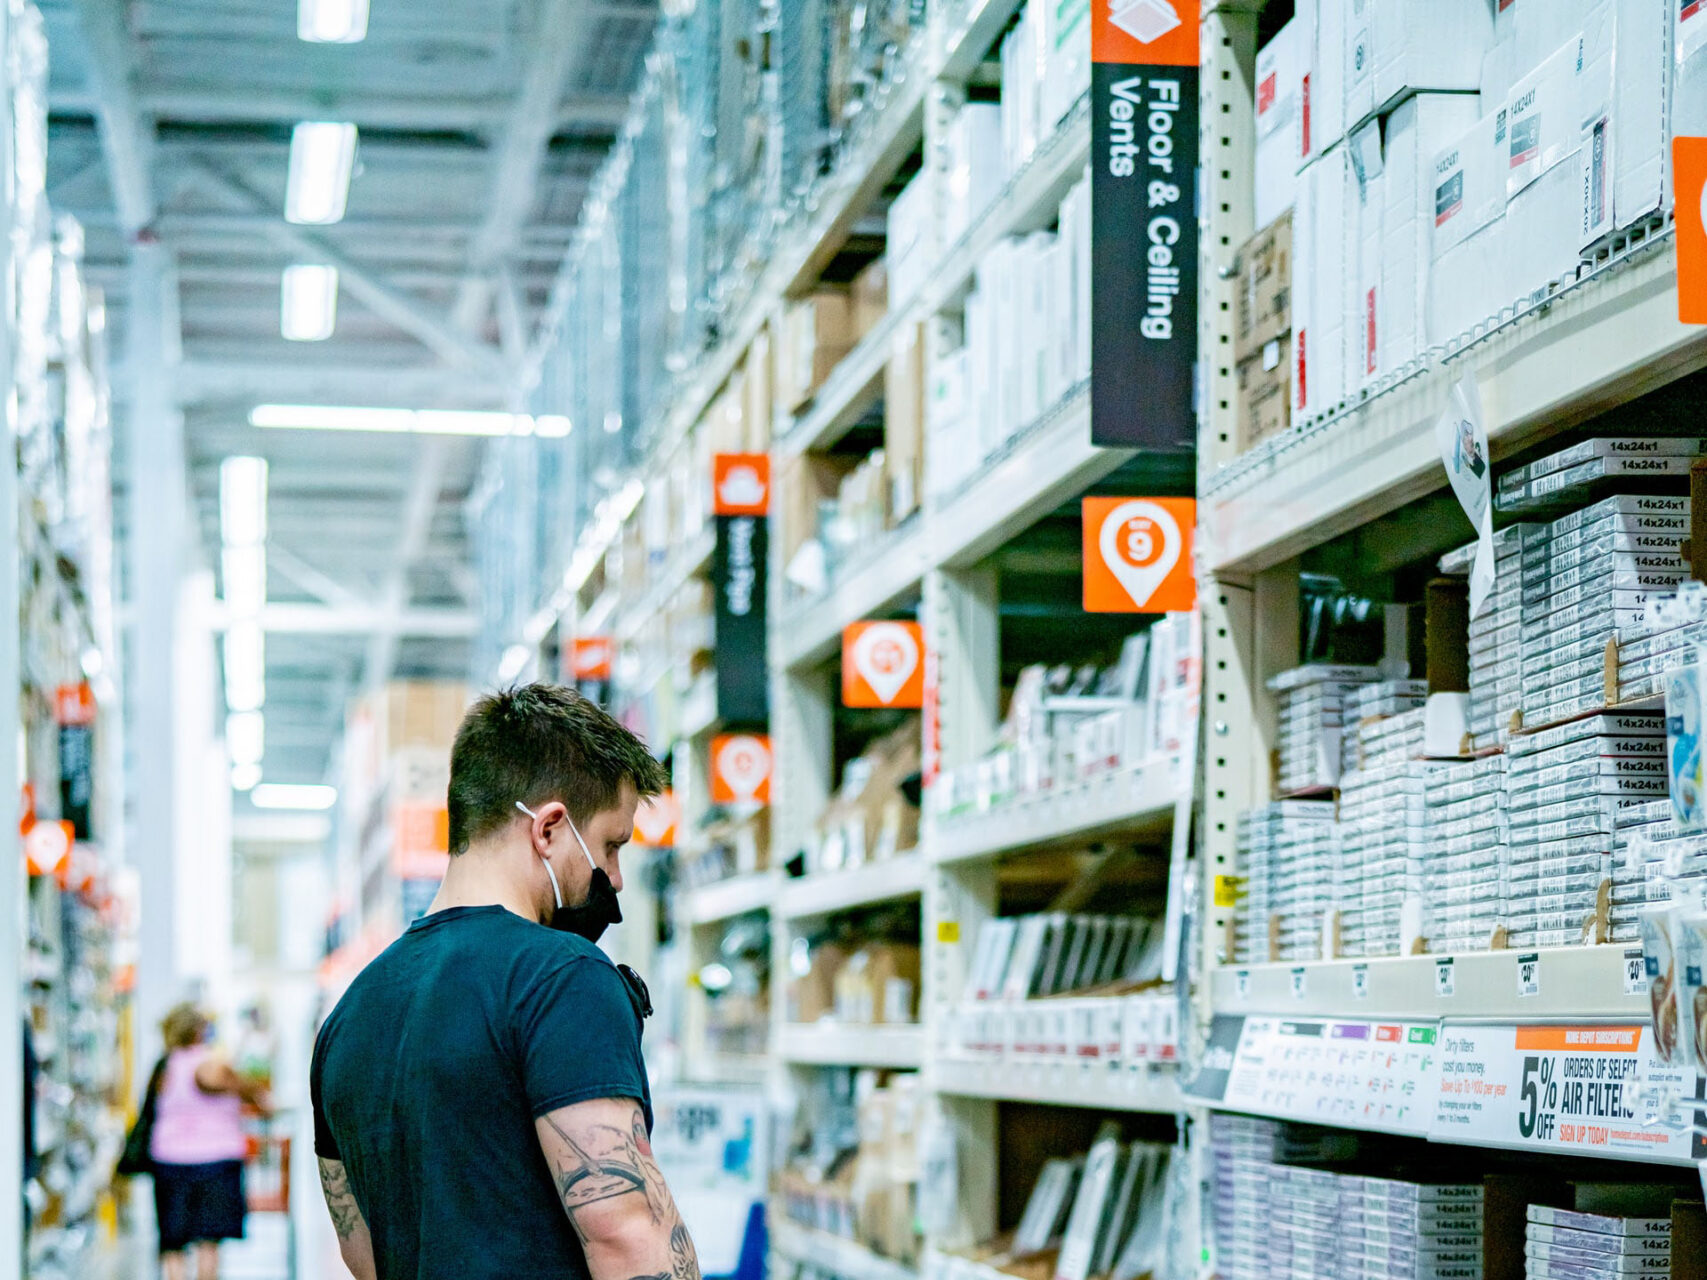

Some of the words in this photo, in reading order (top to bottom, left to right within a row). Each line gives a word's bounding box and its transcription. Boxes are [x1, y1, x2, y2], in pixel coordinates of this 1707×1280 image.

[1109, 76, 1142, 178] Vents
[1148, 79, 1180, 174] Floor
[1147, 180, 1180, 209] &
[1140, 216, 1180, 340] Ceiling
[1610, 441, 1658, 451] 14x24x1
[1621, 460, 1668, 470] 14x24x1
[1637, 500, 1684, 510] 14x24x1
[1637, 518, 1684, 528] 14x24x1
[1127, 531, 1153, 561] 9
[1636, 537, 1683, 547] 14x24x1
[1634, 557, 1682, 567] 14x24x1
[1637, 576, 1684, 586] 14x24x1
[1617, 719, 1665, 728] 14x24x1
[1616, 742, 1664, 752] 14x24x1
[1616, 762, 1664, 772] 14x24x1
[1618, 780, 1665, 790] 14x24x1
[1459, 1038, 1475, 1053] filters
[1443, 1060, 1454, 1073] cost
[1455, 1063, 1465, 1076] you
[1564, 1057, 1594, 1079] ORDERS
[1596, 1058, 1606, 1079] OF
[1561, 1082, 1583, 1115] AIR
[1537, 1113, 1555, 1140] OFF
[1560, 1124, 1575, 1142] SIGN
[1577, 1125, 1586, 1143] UP
[1588, 1127, 1609, 1145] TODAY
